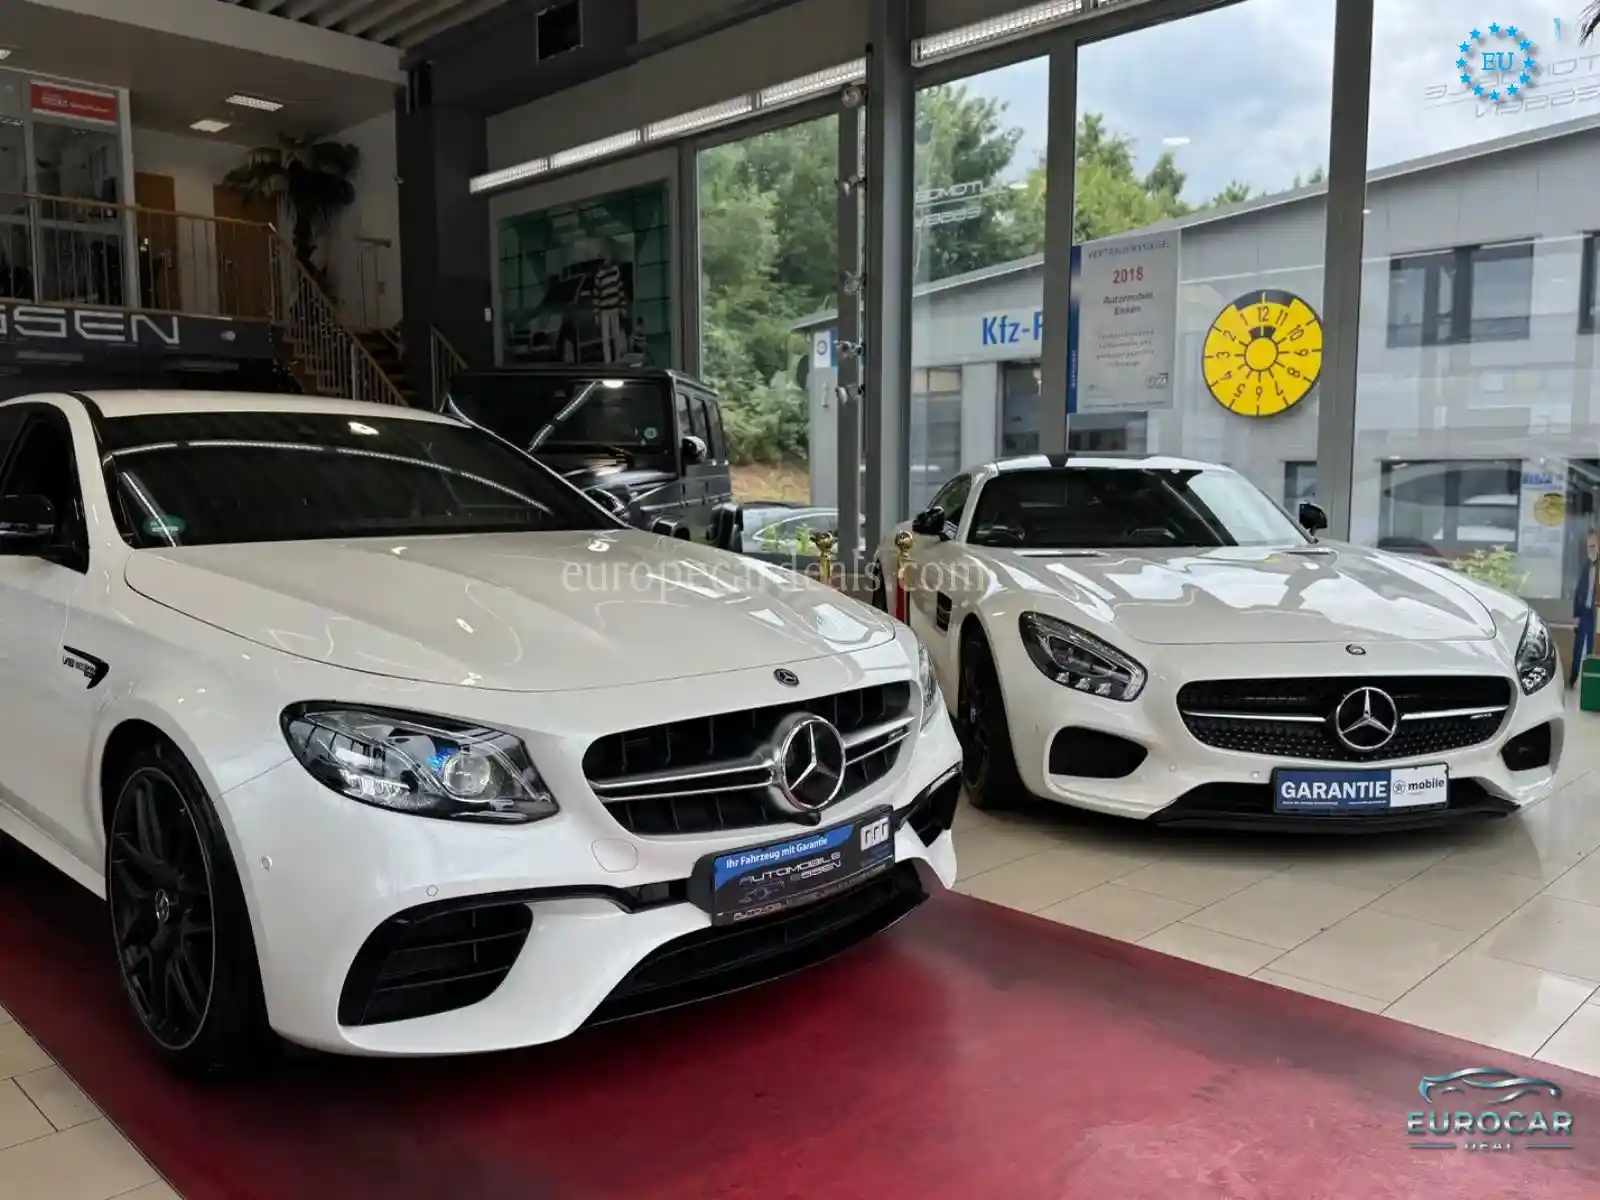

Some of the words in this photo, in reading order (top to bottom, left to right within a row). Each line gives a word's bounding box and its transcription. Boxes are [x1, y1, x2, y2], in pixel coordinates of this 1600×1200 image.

[1112, 266, 1144, 284] 2018
[0, 305, 180, 344] SEN
[1258, 306, 1269, 322] 12
[1281, 781, 1387, 799] GARANTIE
[1408, 777, 1445, 791] mobile
[726, 858, 739, 869] Ihr
[740, 850, 780, 865] Fahrzeug
[782, 844, 795, 856] mit
[796, 837, 828, 853] Garantie
